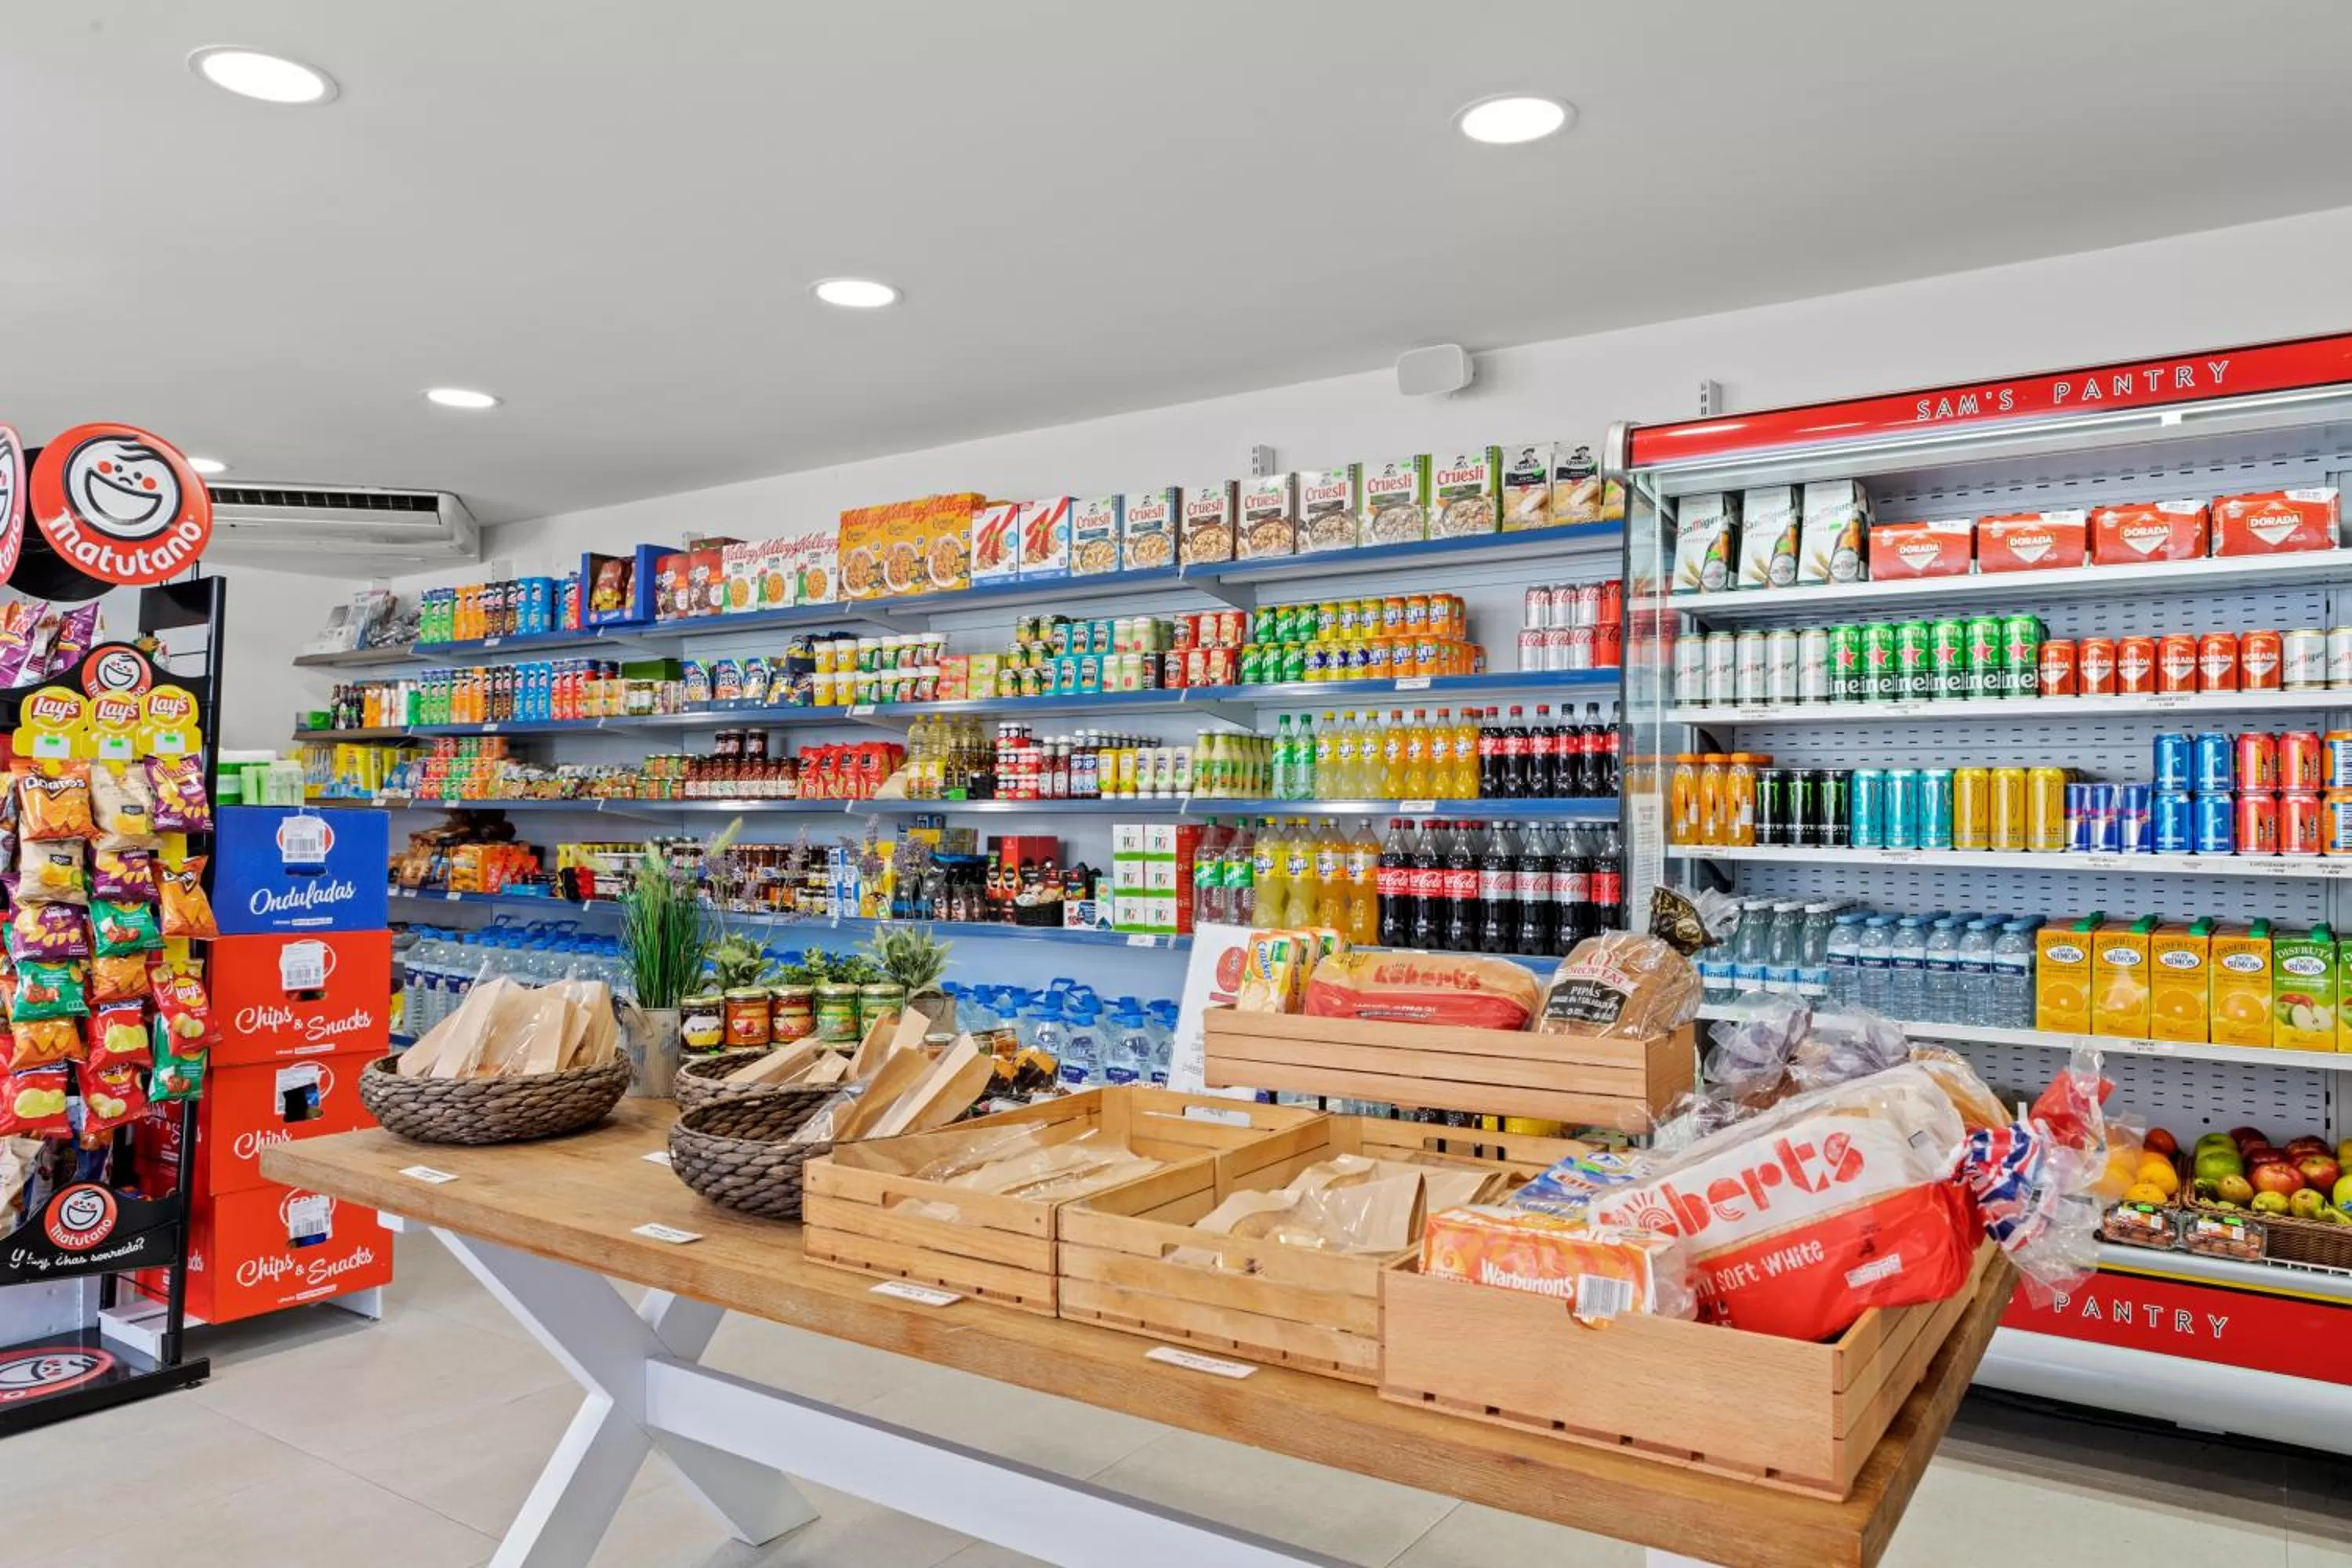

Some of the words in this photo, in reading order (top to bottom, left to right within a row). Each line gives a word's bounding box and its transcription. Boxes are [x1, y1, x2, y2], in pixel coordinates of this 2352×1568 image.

[1917, 390, 2013, 420] SAM'S
[2053, 361, 2230, 404] PANTRY
[1367, 474, 1411, 492] Cruesli
[1437, 466, 1484, 485] Cruesli
[1245, 492, 1283, 510] Cruesli
[1305, 482, 1347, 502] Cruesli
[1129, 504, 1164, 521] Cruesli
[1187, 496, 1223, 516] Cruesli
[1076, 512, 1111, 528] Cruesli
[2250, 515, 2300, 528] DORADA
[2124, 526, 2169, 537] DORADA
[48, 507, 201, 576] matutano
[1900, 543, 1940, 554] DORADA
[2009, 536, 2053, 546] DORADA
[34, 696, 79, 722] Lay's
[96, 699, 139, 724] Lay's
[151, 695, 188, 717] Lay's
[1084, 758, 1096, 769] HP
[250, 880, 356, 916] Onduladas
[2051, 951, 2081, 960] SIMON
[2107, 954, 2138, 963] SIMON
[2165, 957, 2196, 967] SIMON
[2276, 946, 2333, 960] DISFRUTA
[2227, 959, 2260, 969] SIMON
[2288, 963, 2322, 972] SIMON
[236, 1006, 293, 1033] Chips
[294, 1020, 303, 1029] &
[305, 1009, 373, 1041] Snacks
[50, 1218, 112, 1246] matutano
[237, 1254, 295, 1287] Chips
[296, 1265, 304, 1276] &
[307, 1247, 374, 1285] Snacks
[1480, 1258, 1574, 1299] Warburtons
[2053, 1290, 2228, 1338] PANTRY
